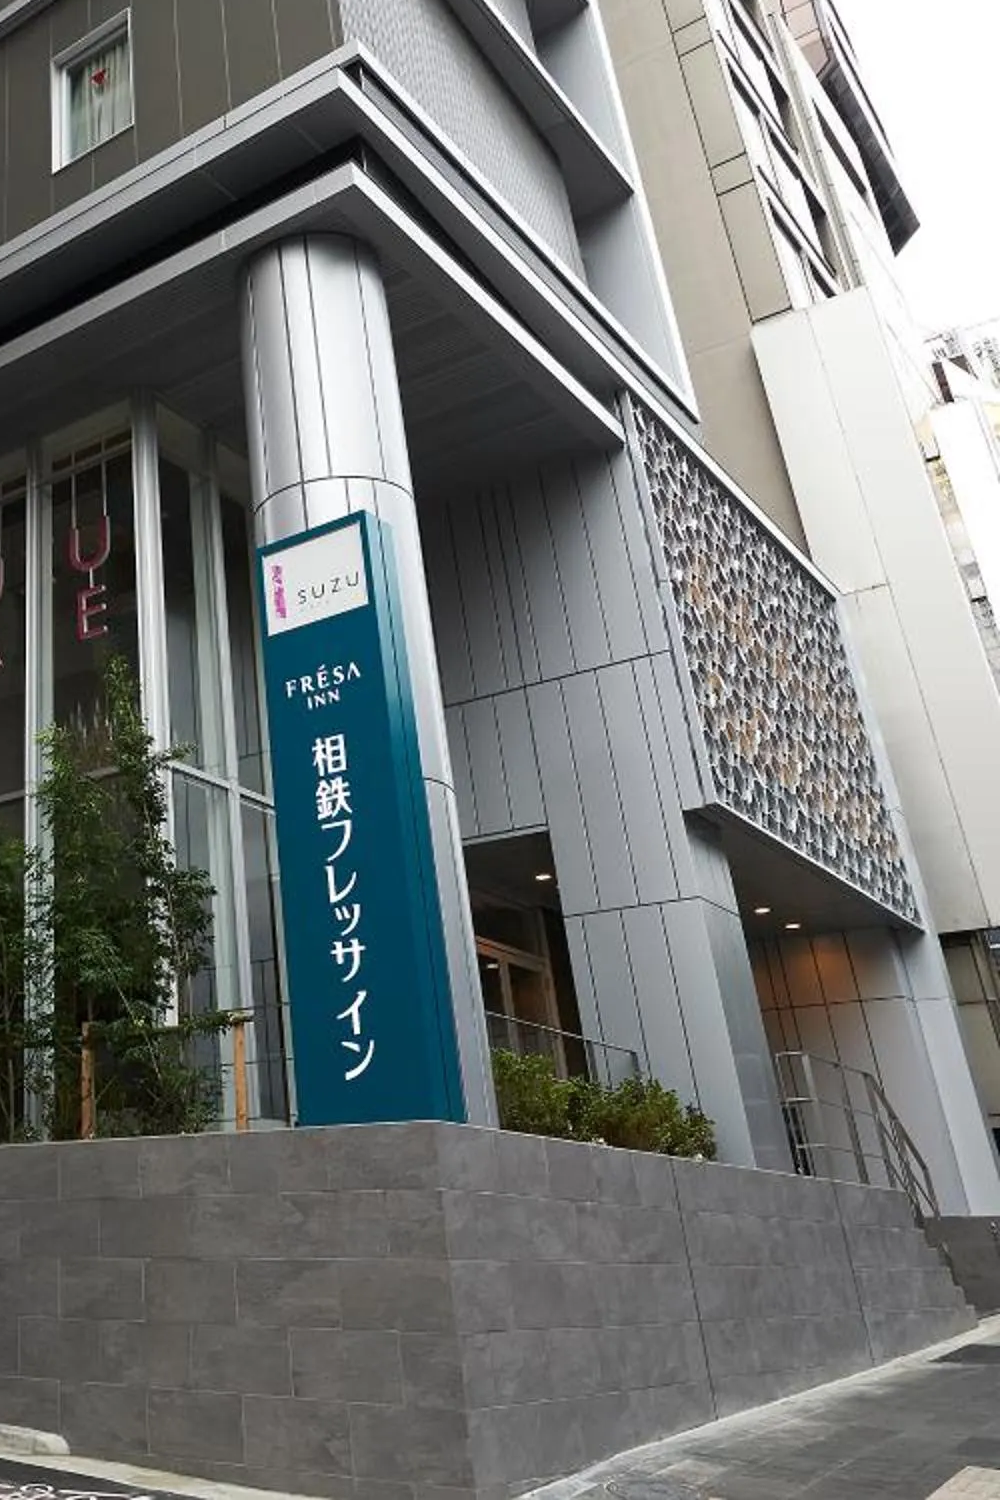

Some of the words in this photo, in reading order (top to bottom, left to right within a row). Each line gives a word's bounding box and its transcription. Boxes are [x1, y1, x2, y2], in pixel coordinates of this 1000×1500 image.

[297, 571, 359, 605] SUZU
[285, 661, 361, 698] FRÉSA
[307, 688, 340, 711] INN
[311, 733, 375, 1081] 相鉄フレッサイン
